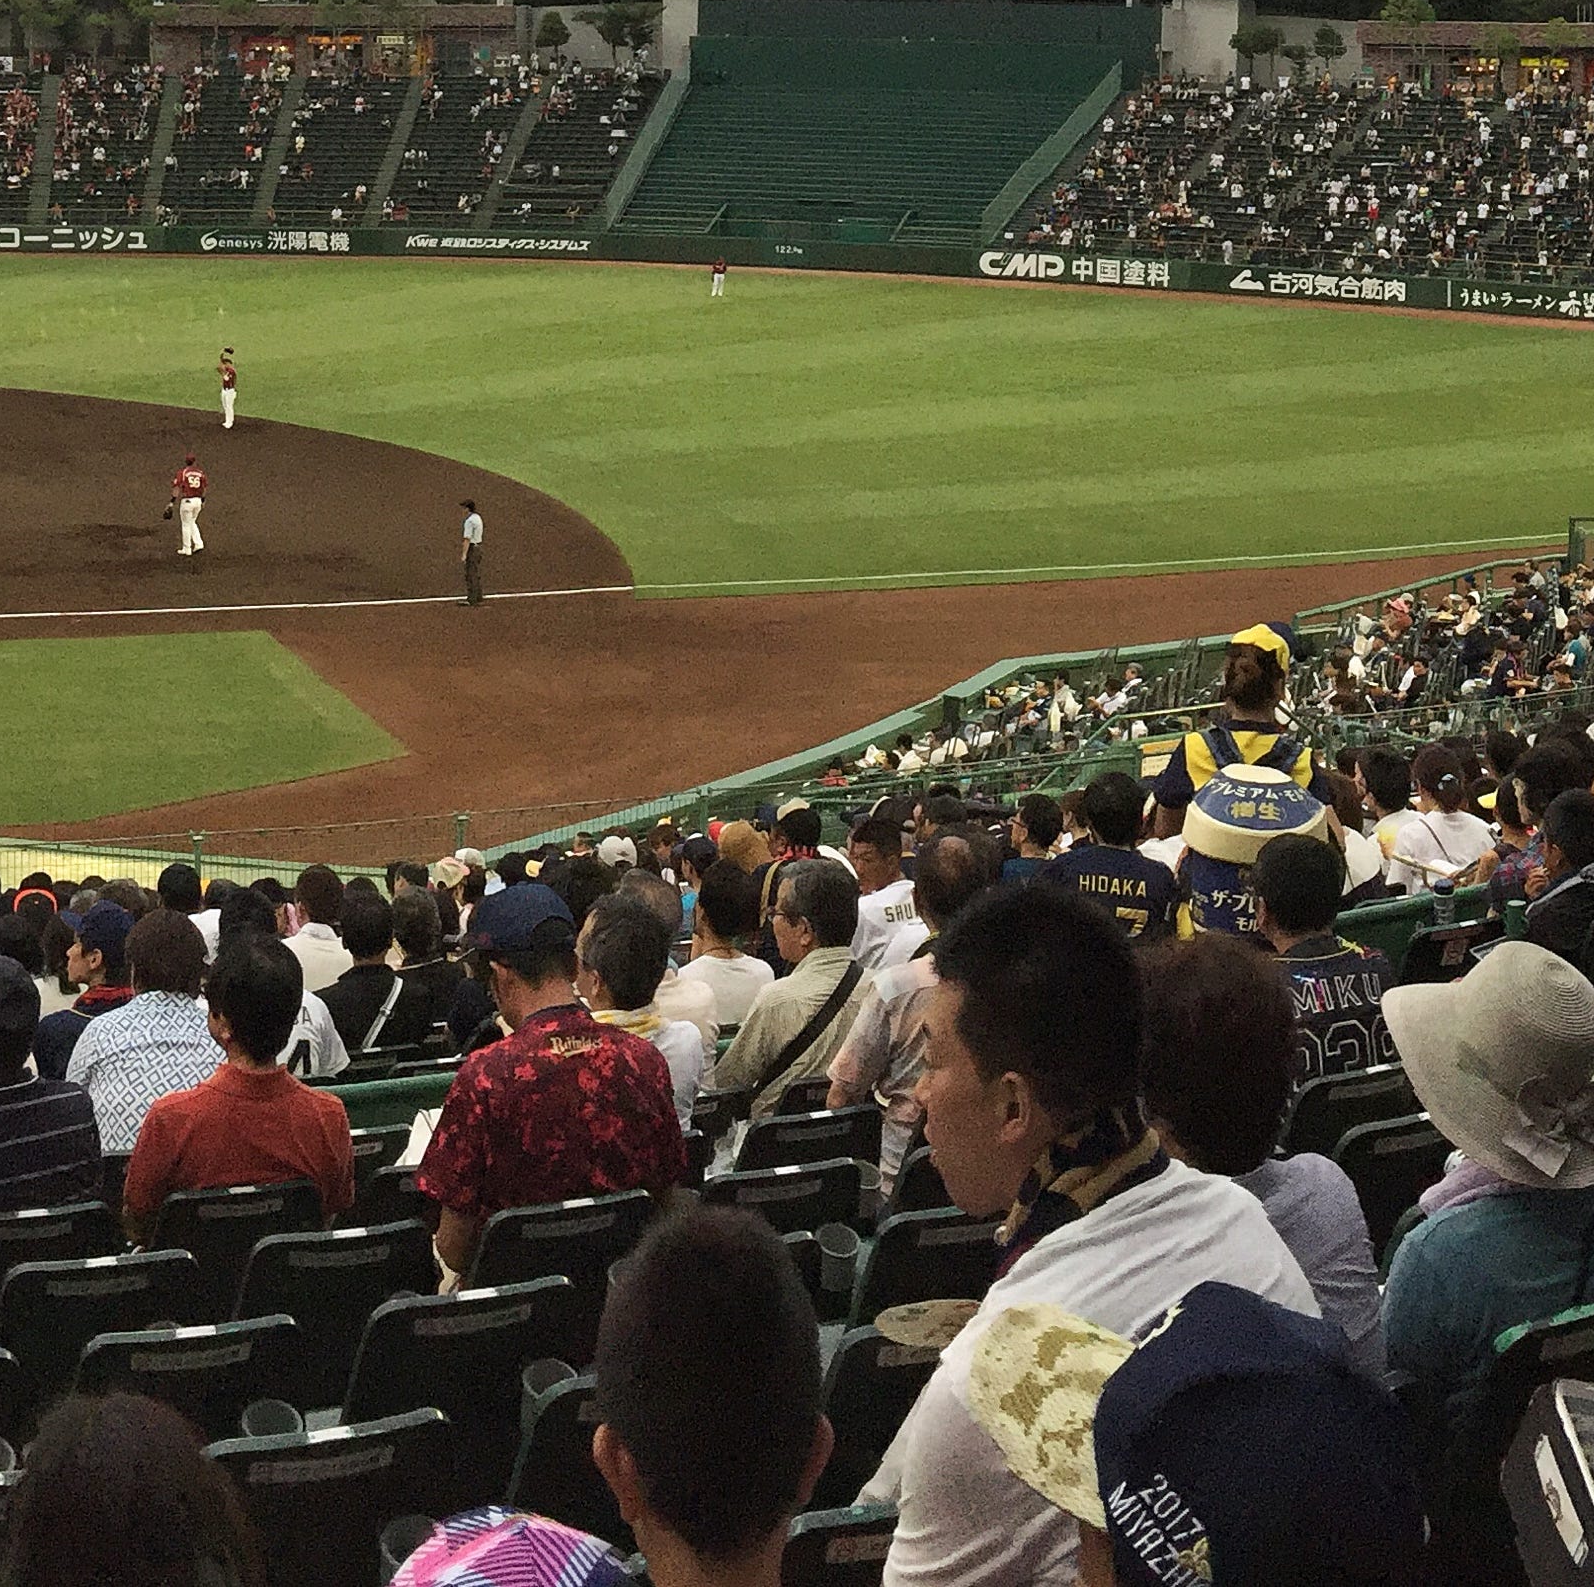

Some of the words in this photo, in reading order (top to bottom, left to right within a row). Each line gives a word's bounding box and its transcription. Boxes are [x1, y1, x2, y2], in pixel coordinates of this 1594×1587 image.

[0, 227, 148, 250] コーニッシュ
[267, 230, 350, 252] 洸陽電機
[979, 251, 1065, 278] CMP
[1071, 256, 1171, 288] 中国塗料
[1268, 272, 1406, 302] 古河気合筋肉
[1079, 874, 1146, 898] HIDAKA
[1139, 1473, 1206, 1542] 2017
